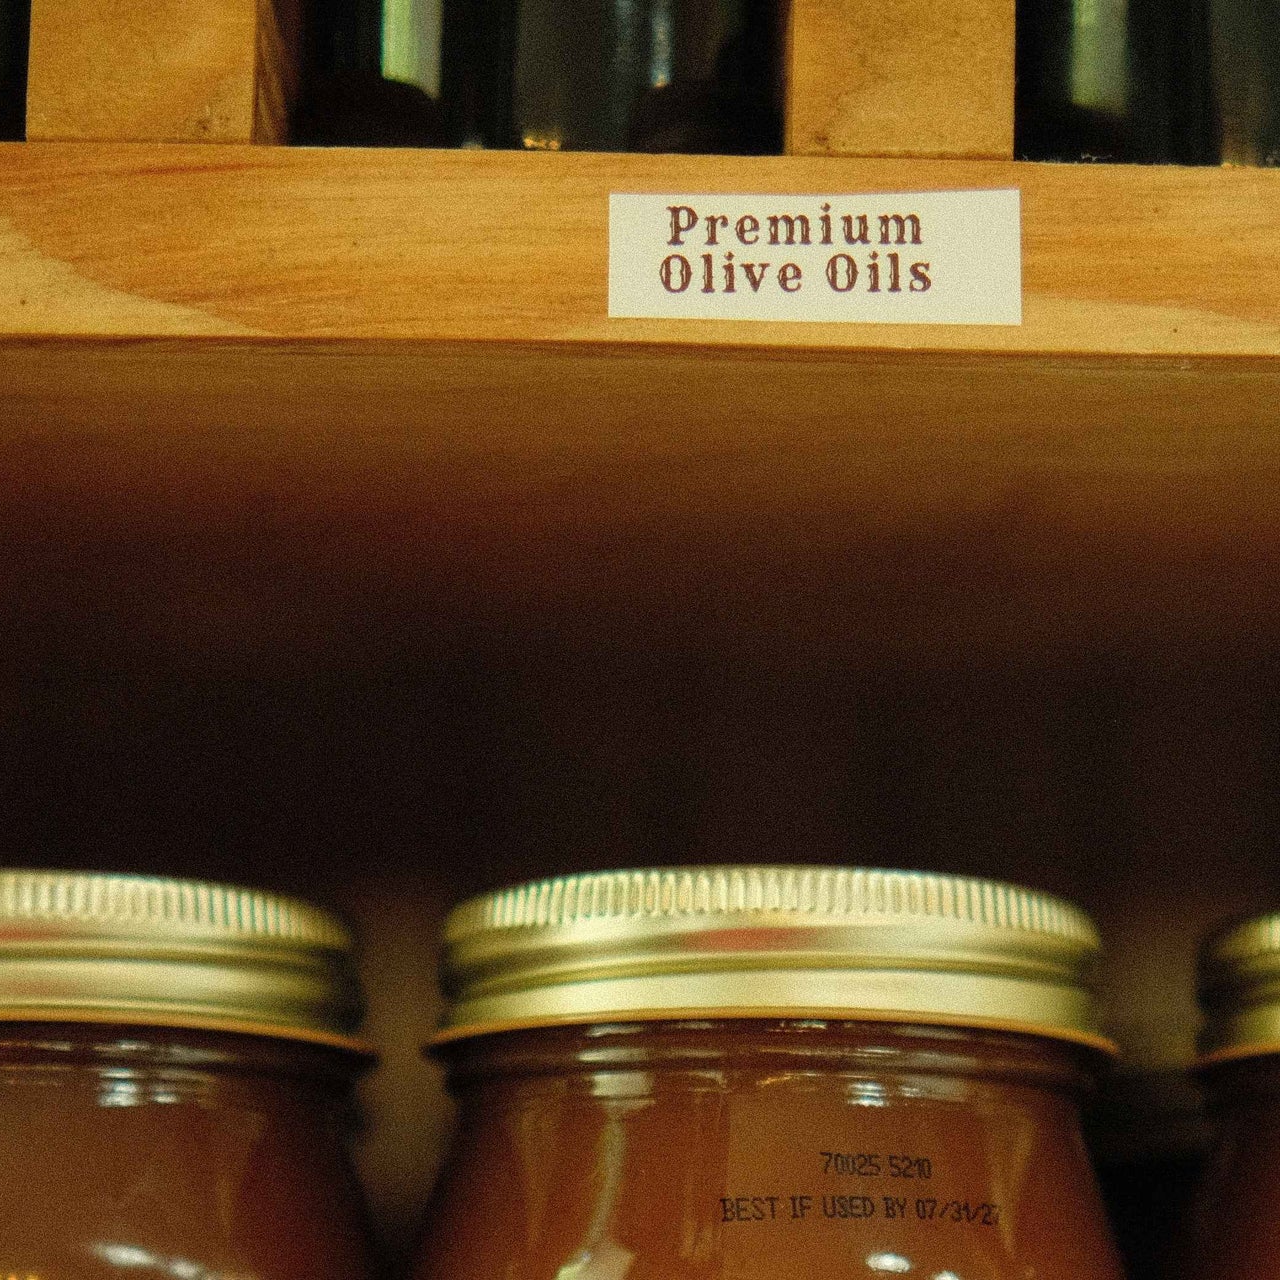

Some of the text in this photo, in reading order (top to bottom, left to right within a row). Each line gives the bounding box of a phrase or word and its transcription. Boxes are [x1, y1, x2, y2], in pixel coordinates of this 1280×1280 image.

[666, 202, 923, 245] Premium
[660, 251, 932, 293] Olive Oils
[820, 1152, 933, 1180] 70025 5210
[720, 1197, 779, 1222] BEST
[789, 1196, 816, 1219] IF
[822, 1196, 875, 1219] USED
[883, 1197, 907, 1219] BY
